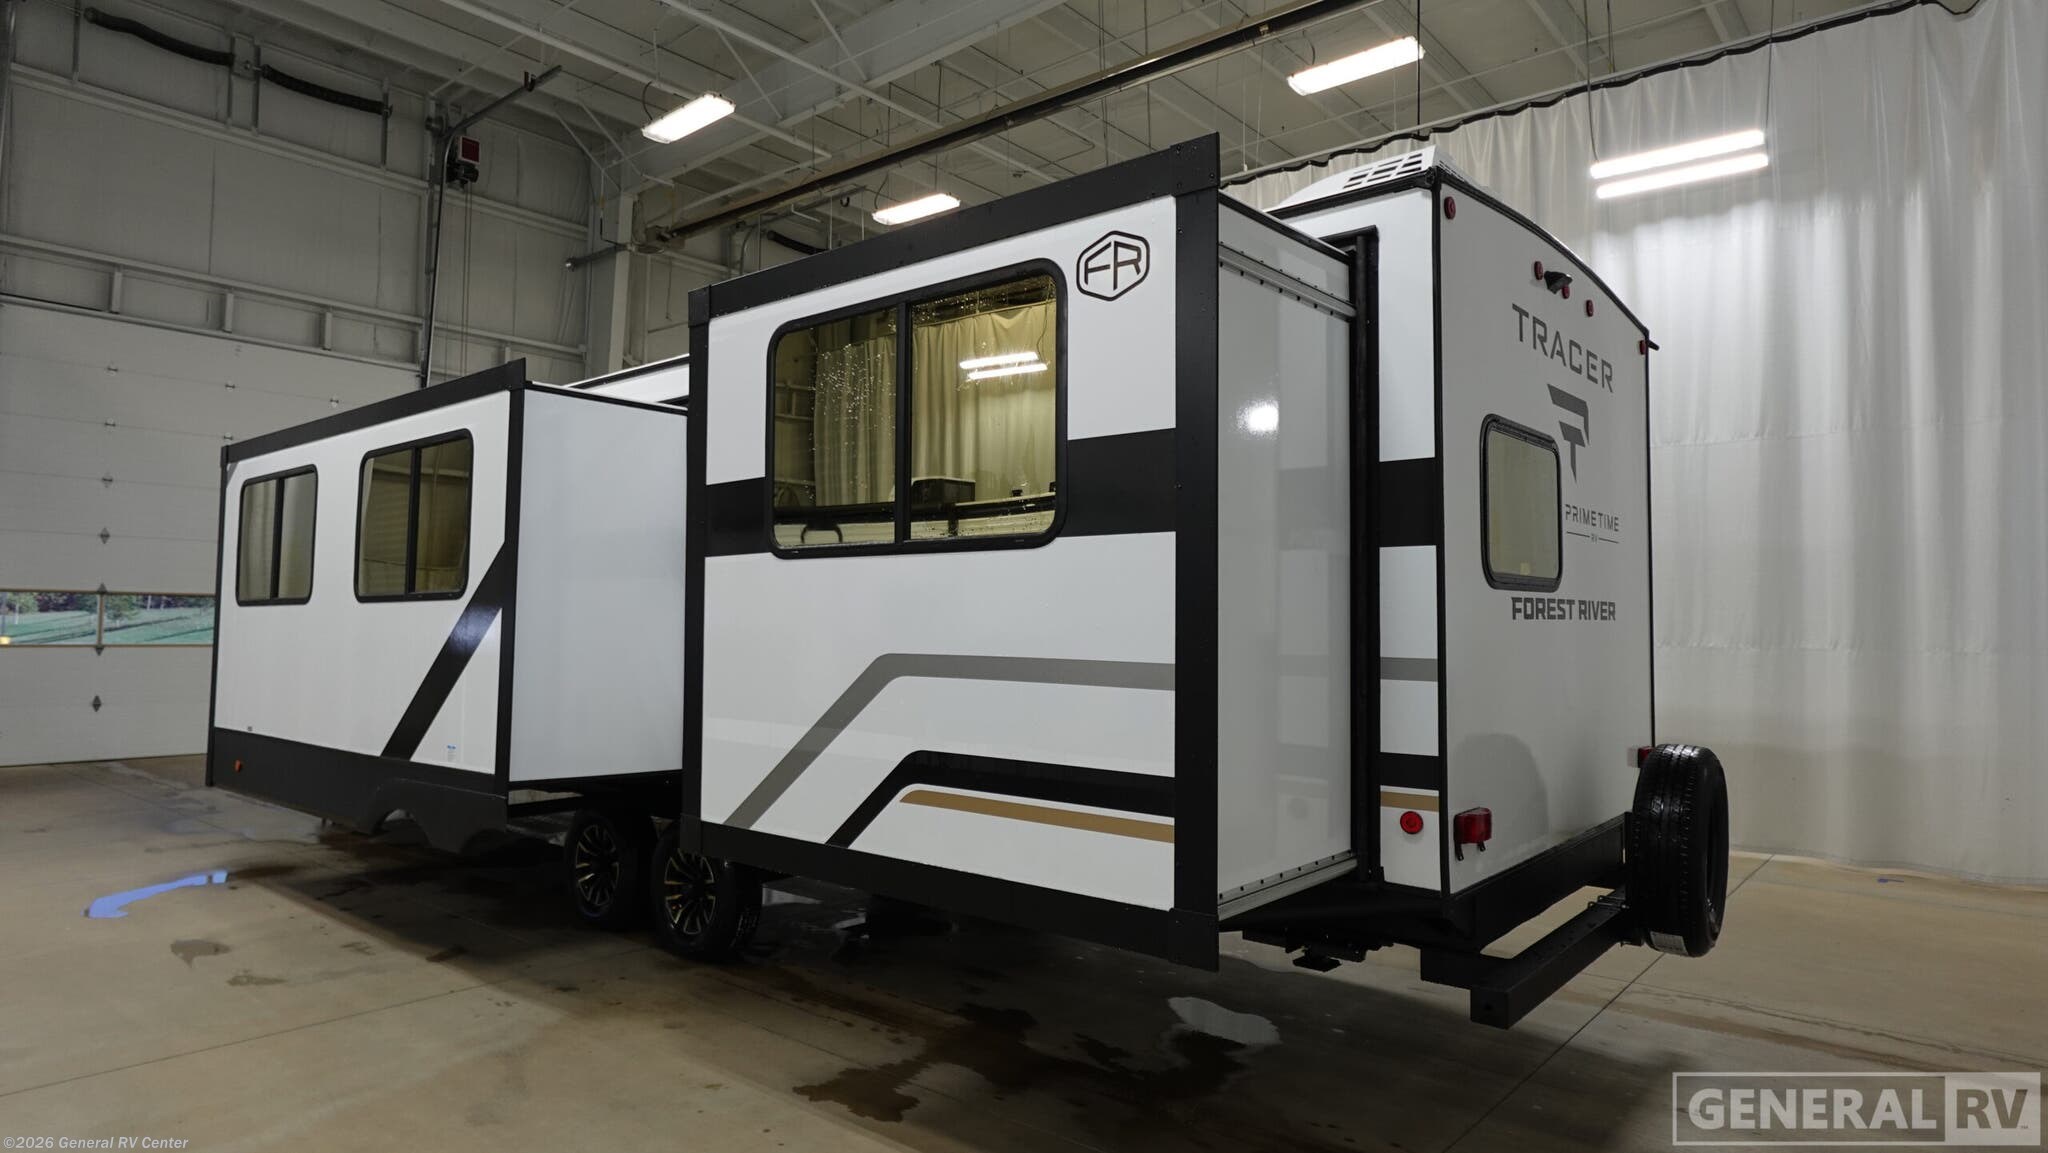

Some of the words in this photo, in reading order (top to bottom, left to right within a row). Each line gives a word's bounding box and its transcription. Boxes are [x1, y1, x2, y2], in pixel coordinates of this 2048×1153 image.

[1512, 303, 1614, 393] TRACER
[1511, 597, 1576, 621] FOREST
[1578, 599, 1616, 621] RIVER
